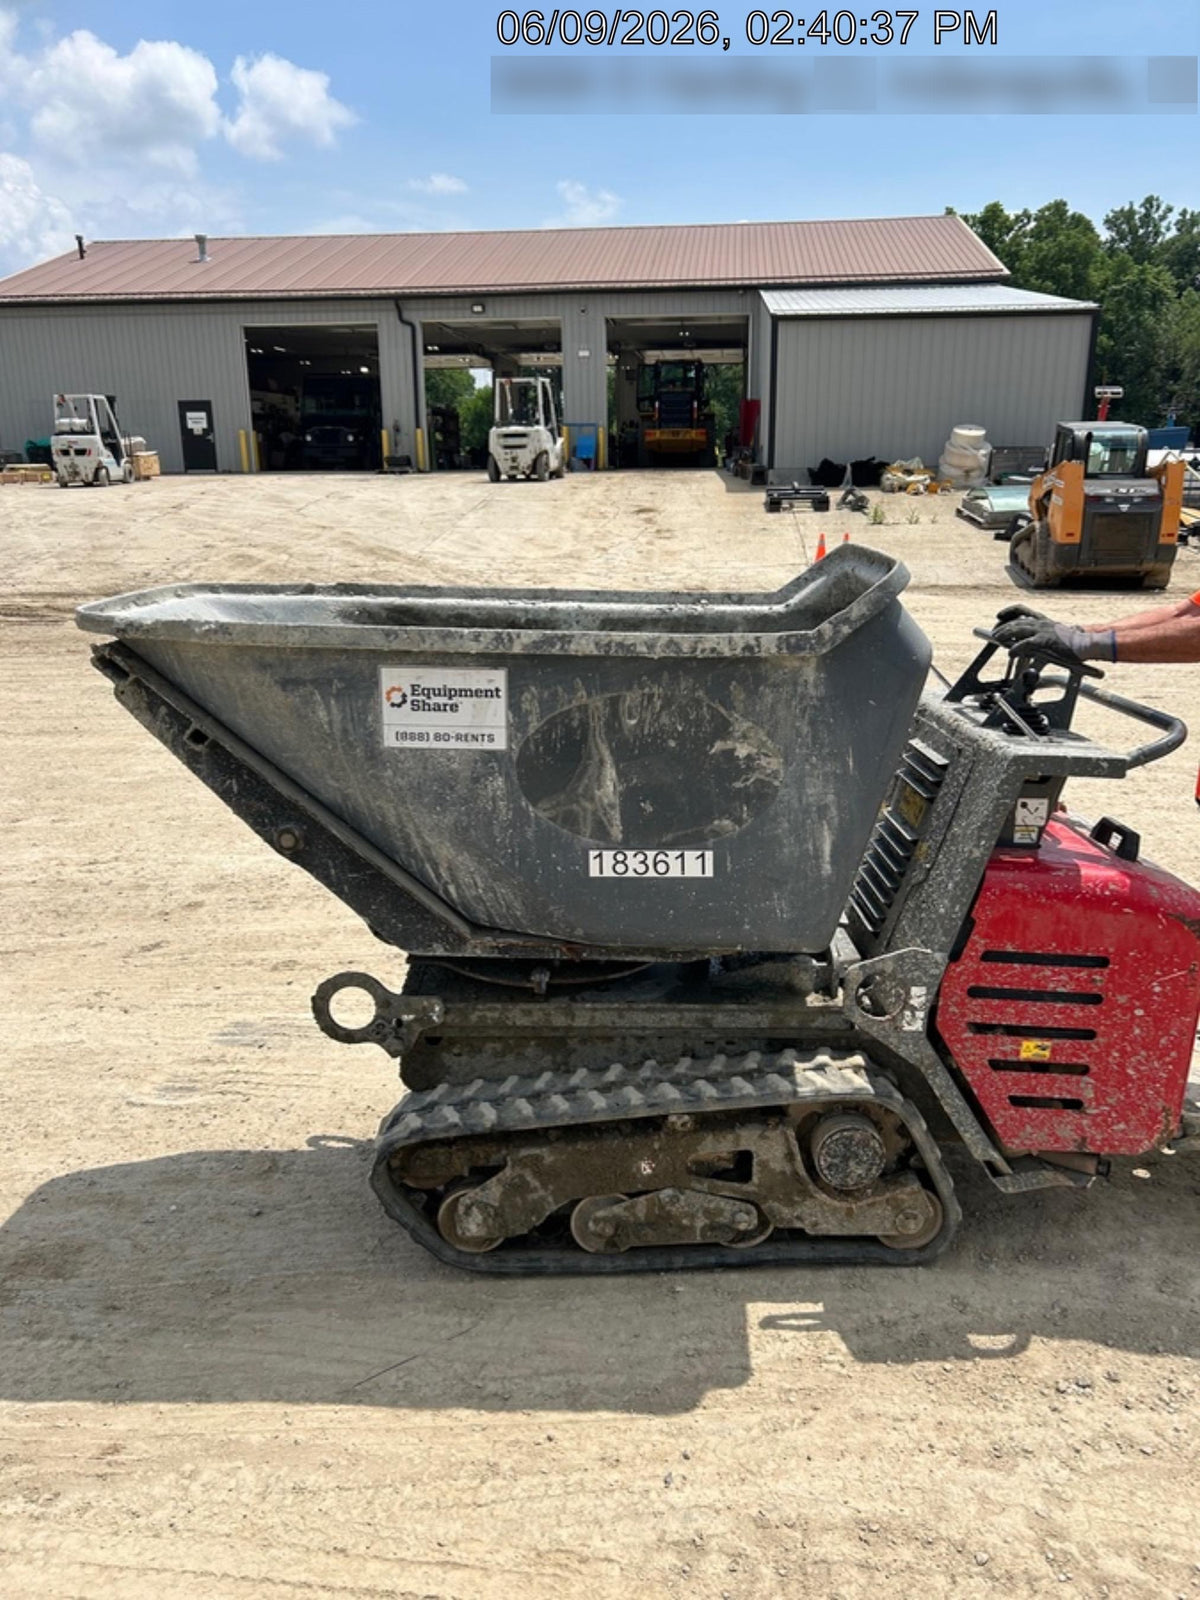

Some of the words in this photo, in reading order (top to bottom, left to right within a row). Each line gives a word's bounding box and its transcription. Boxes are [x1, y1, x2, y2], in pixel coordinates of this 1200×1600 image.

[410, 684, 502, 700] Equipment
[410, 699, 460, 712] Share
[395, 731, 430, 742] (888)
[433, 732, 495, 743] 80-RENTS
[593, 851, 706, 875] 183611
